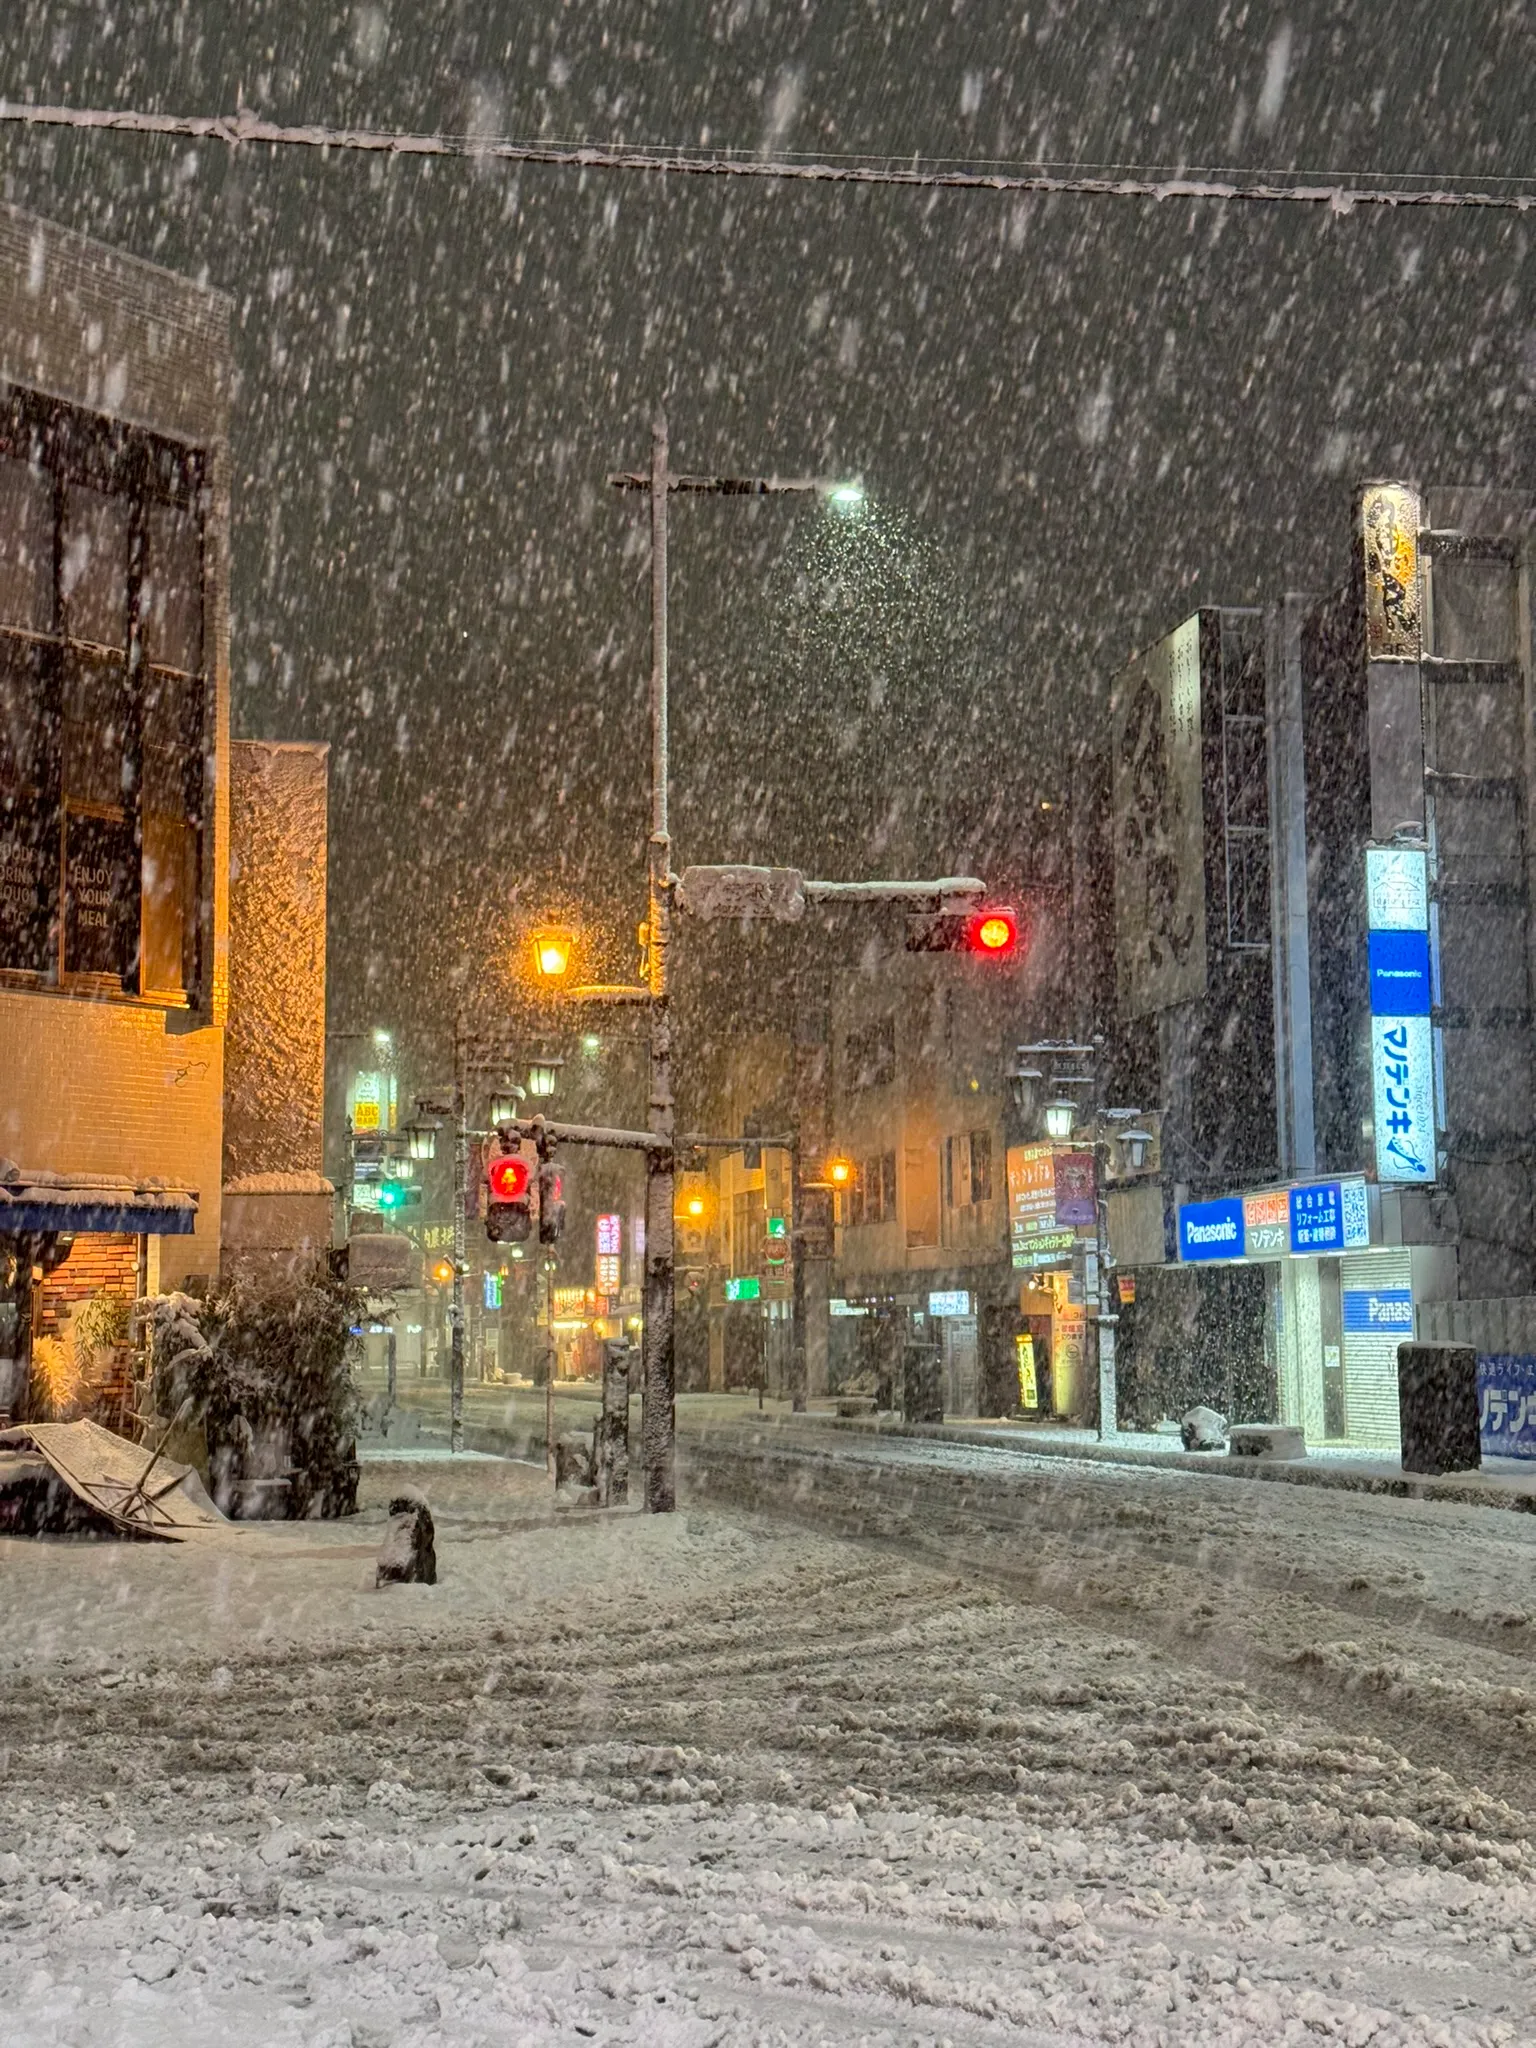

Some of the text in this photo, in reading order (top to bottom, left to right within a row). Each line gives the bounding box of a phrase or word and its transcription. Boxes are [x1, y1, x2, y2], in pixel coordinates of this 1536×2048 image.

[74, 866, 113, 885] ENJOY
[78, 887, 111, 907] YOUR
[78, 909, 109, 928] MEAL
[1377, 968, 1422, 978] Panasonic
[1384, 1025, 1413, 1134] マノテンキ
[1186, 1216, 1237, 1244] Panasonic
[1250, 1228, 1285, 1248] マノテンキ
[1368, 1297, 1412, 1322] Panas
